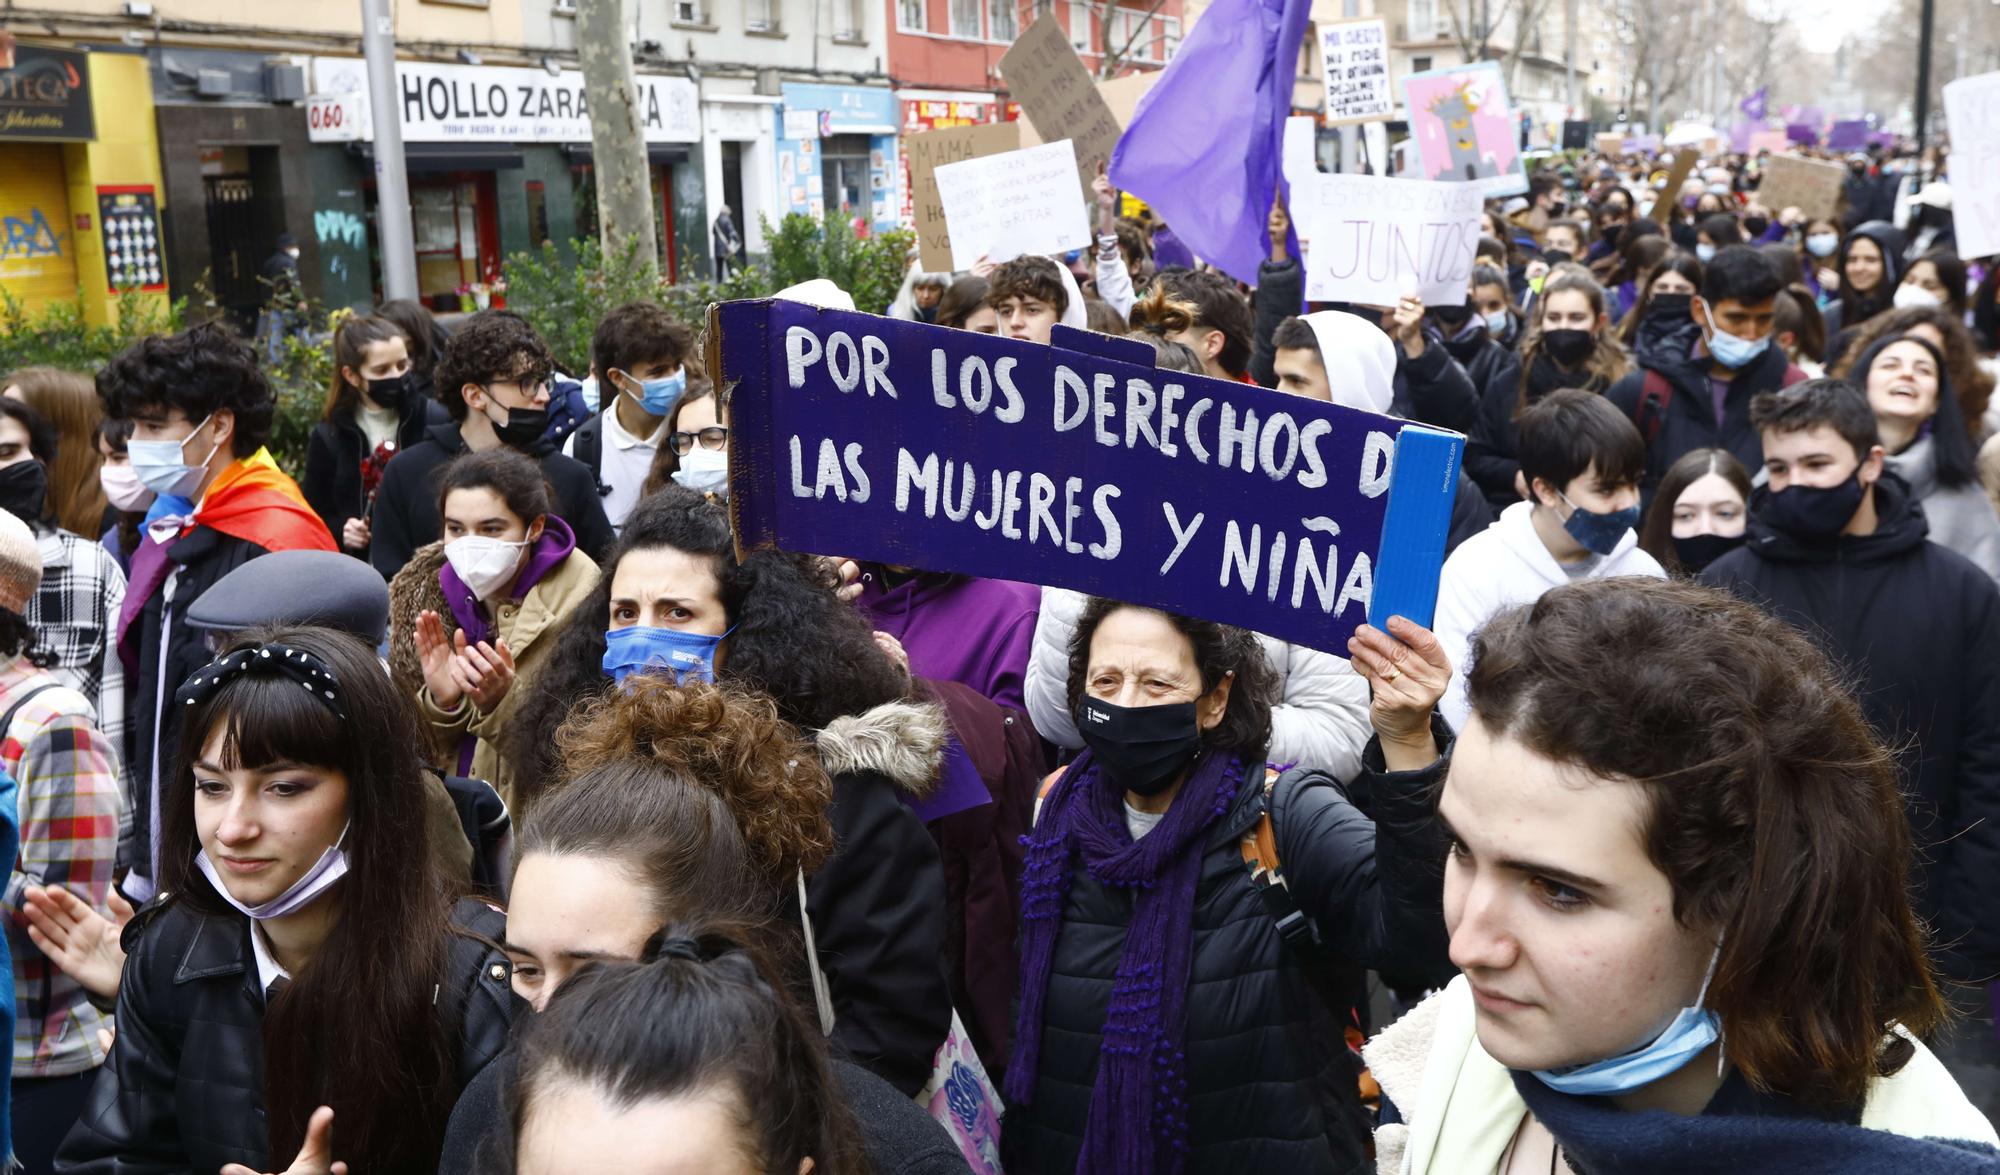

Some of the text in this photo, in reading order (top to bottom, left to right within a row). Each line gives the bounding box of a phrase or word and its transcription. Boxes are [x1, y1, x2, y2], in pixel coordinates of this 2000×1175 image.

[0, 74, 68, 101] TECA
[402, 74, 662, 128] HOLLO ZARAA
[916, 135, 975, 171] MAMÁ
[1000, 207, 1053, 230] GRITAR
[1321, 182, 1416, 212] ESTAMOS
[1330, 218, 1478, 284] JUNTOS
[785, 325, 1395, 499] POR LOS DERECHOS D
[1441, 442, 1457, 493] simonelectric.com
[789, 434, 1373, 619] LAS MUJERES Y NIÑA
